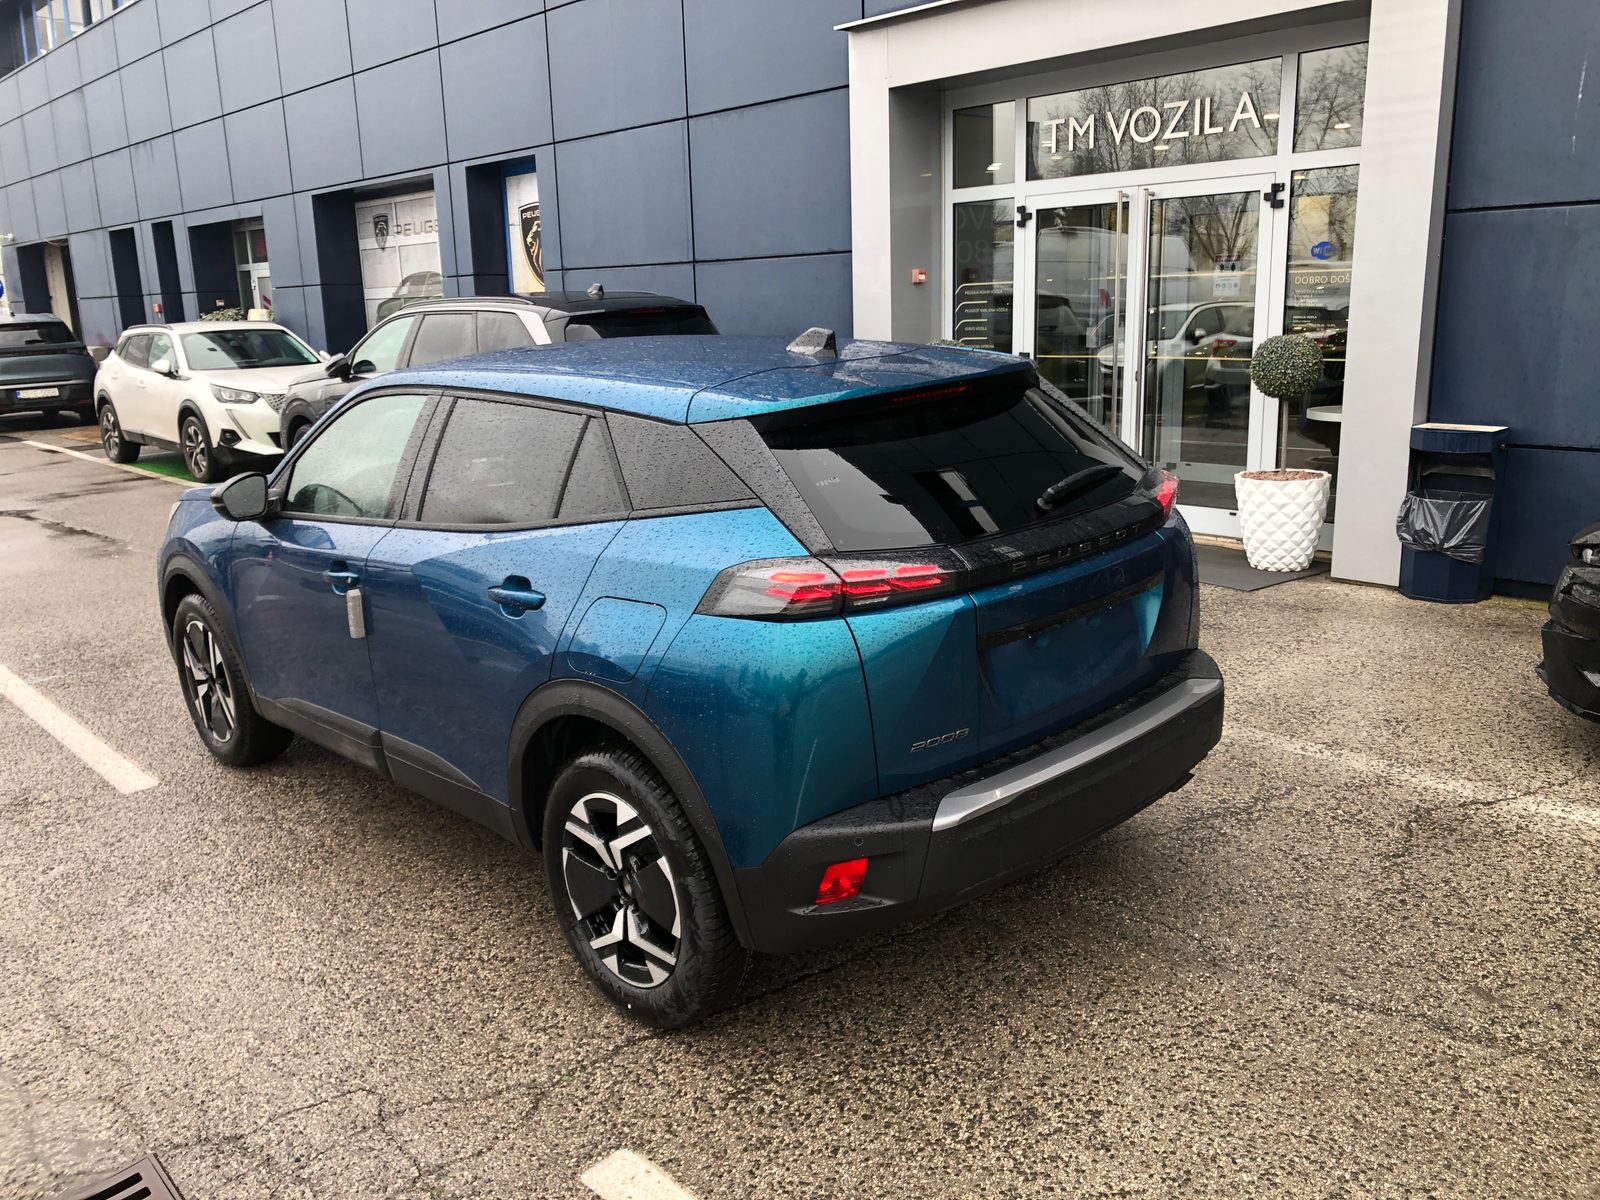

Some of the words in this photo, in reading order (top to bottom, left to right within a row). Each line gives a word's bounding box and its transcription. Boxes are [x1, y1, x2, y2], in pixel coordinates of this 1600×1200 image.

[1044, 114, 1095, 153] TM
[1107, 92, 1260, 145] VOZILA
[1294, 276, 1328, 284] DOBRO
[1330, 273, 1350, 283] DOŠ
[1012, 523, 1143, 573] PEUGEOT
